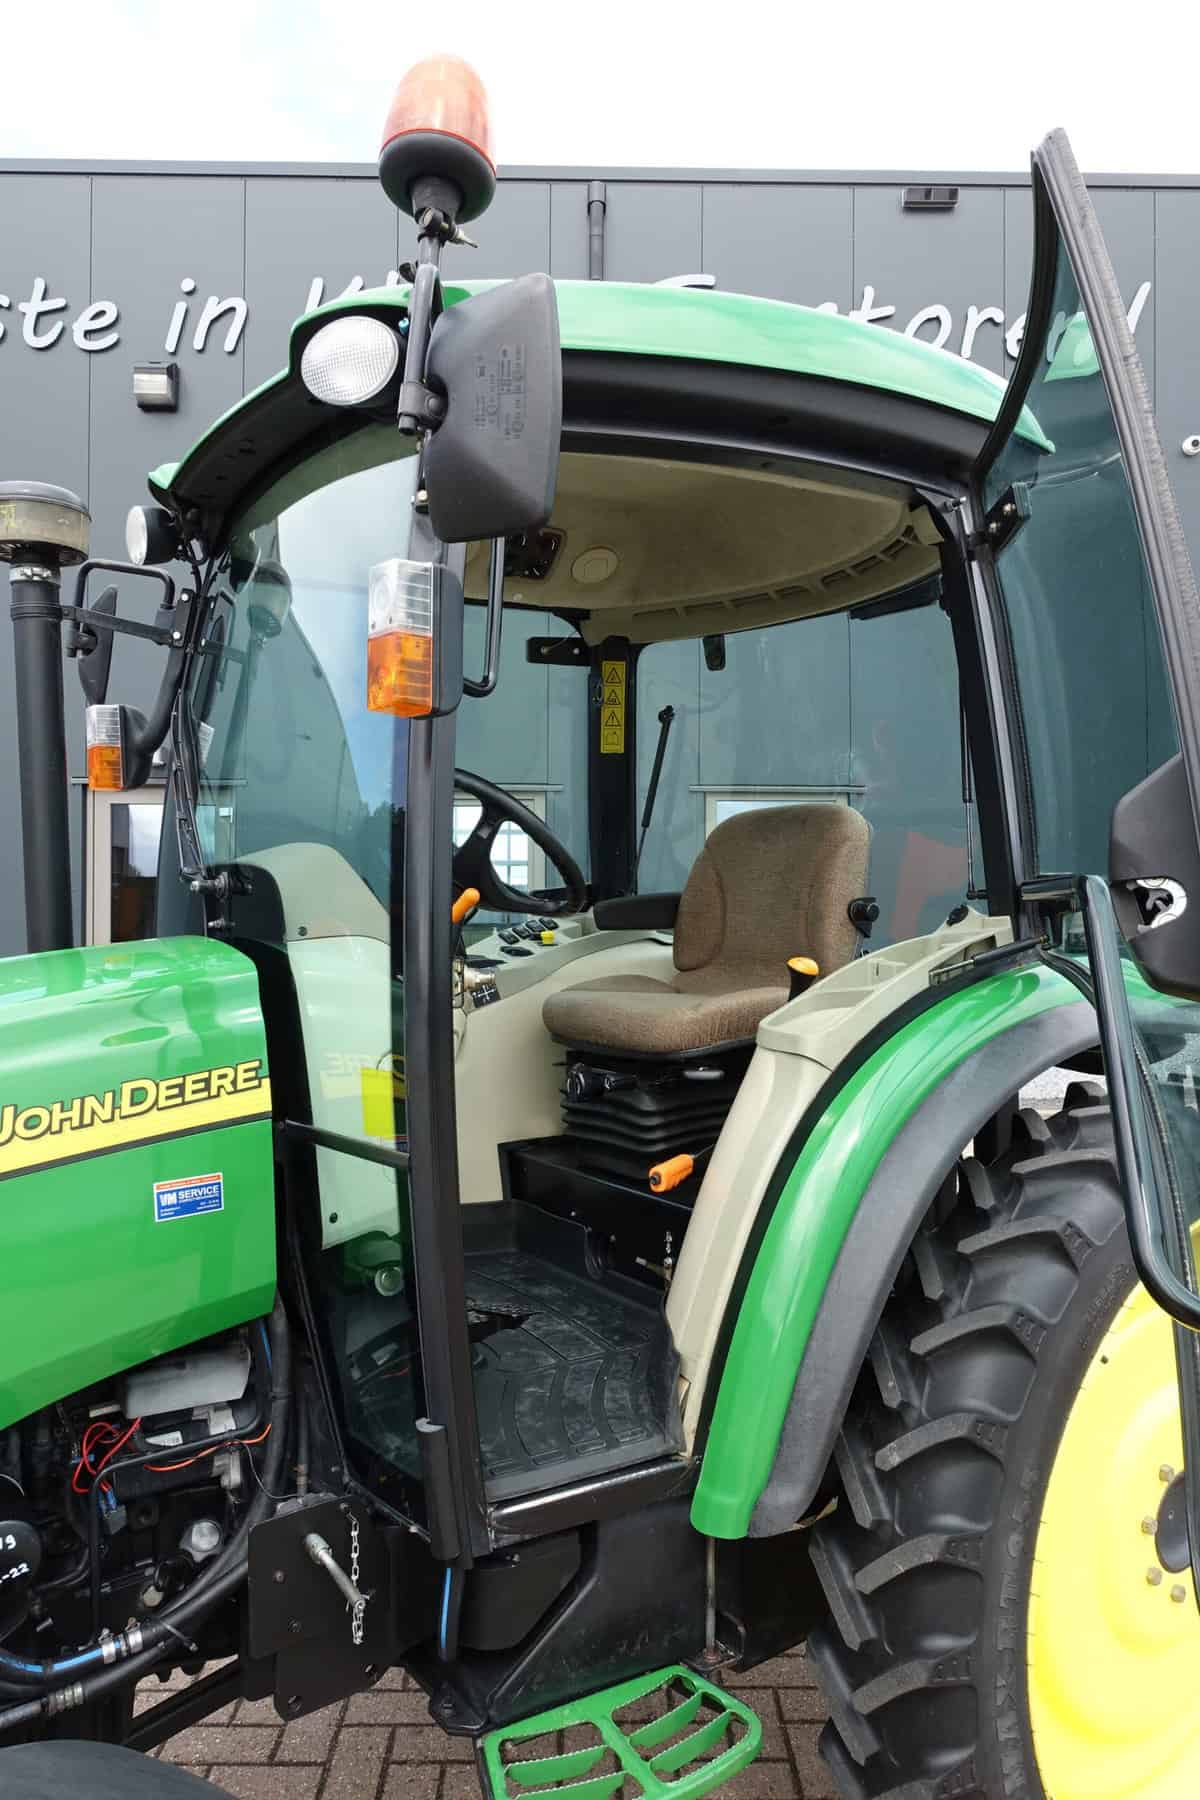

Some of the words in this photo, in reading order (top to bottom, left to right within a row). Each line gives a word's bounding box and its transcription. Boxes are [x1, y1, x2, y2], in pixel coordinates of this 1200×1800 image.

[164, 277, 248, 353] in
[0, 1090, 114, 1147] JOHN
[118, 1058, 262, 1119] DEERE
[178, 1184, 220, 1200] SERVICE
